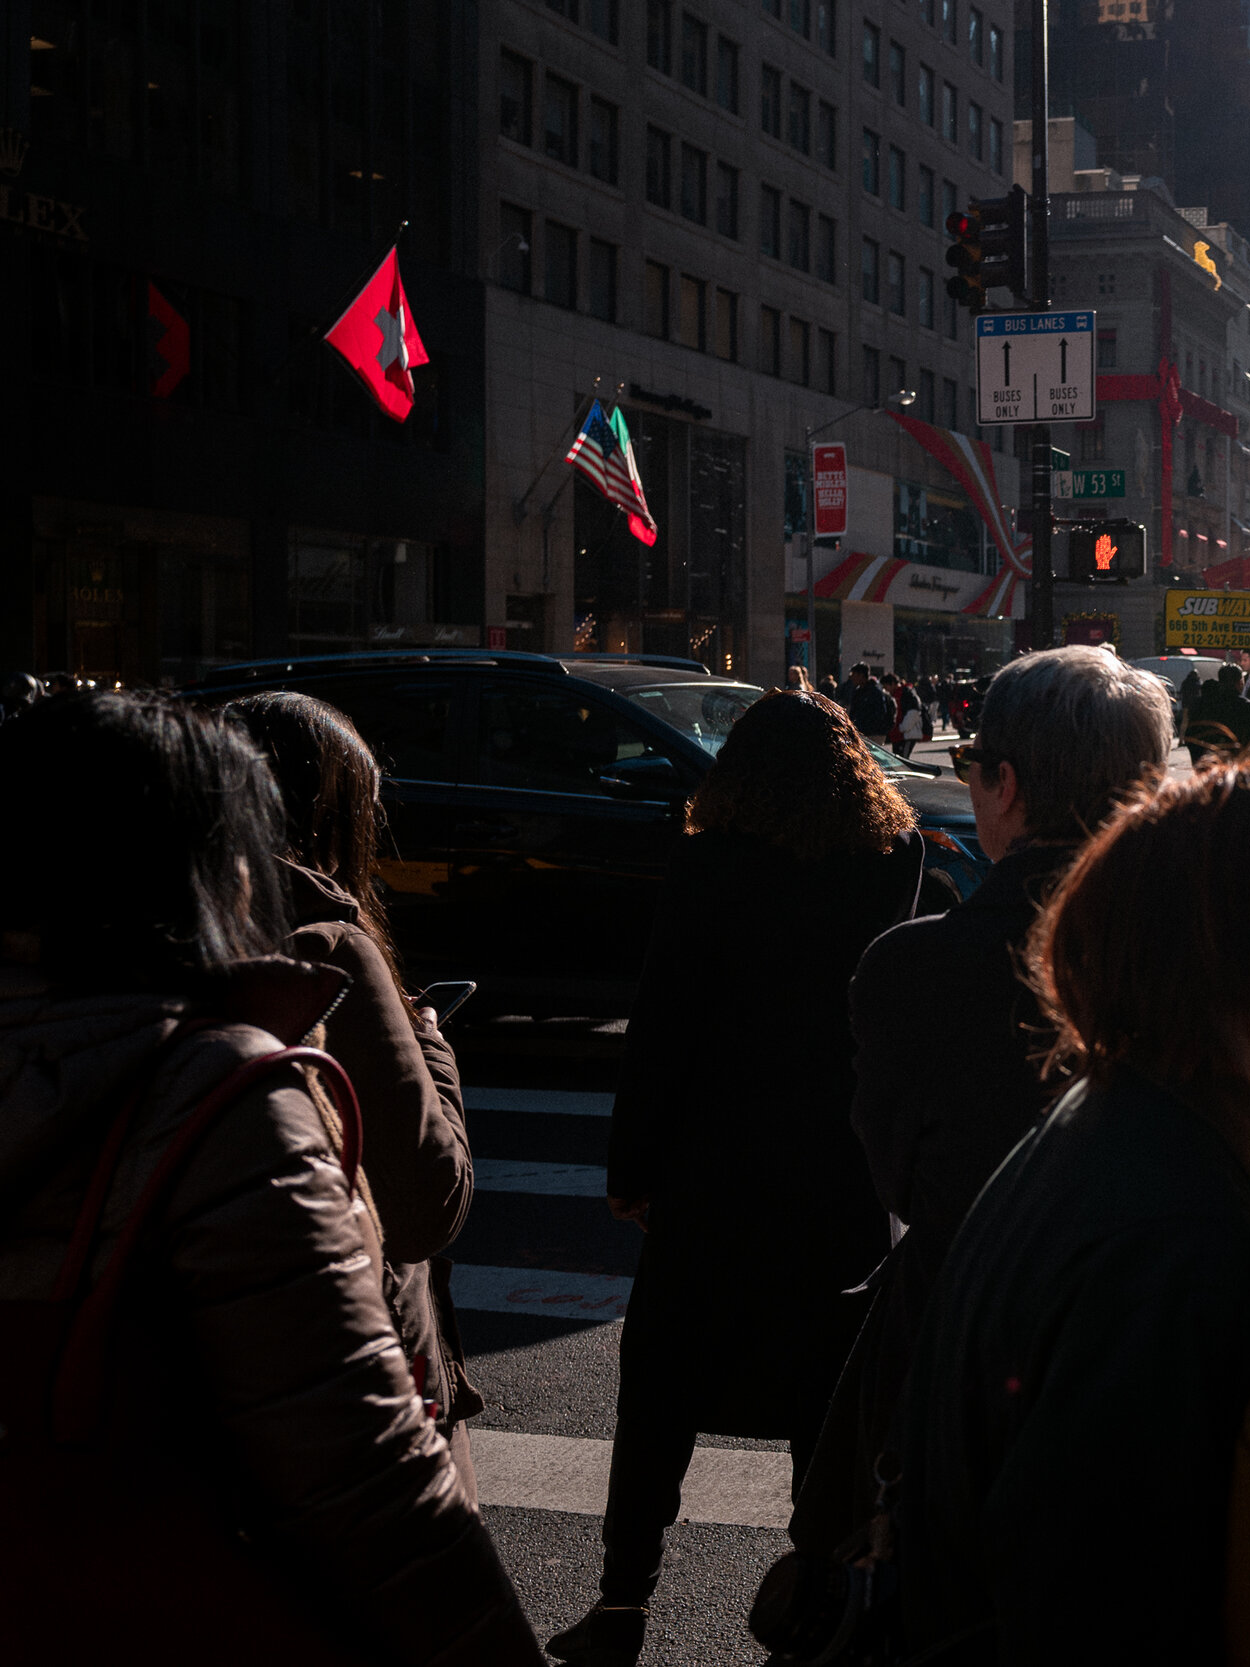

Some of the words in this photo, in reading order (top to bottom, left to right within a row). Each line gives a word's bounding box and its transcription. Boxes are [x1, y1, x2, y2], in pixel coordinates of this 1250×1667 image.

[0, 184, 88, 240] LEX
[1004, 318, 1027, 332] BUS
[1030, 317, 1066, 331] LANES
[993, 390, 1021, 403] BUSES
[1049, 387, 1078, 400] BUSES
[995, 405, 1020, 418] ONLY
[1051, 403, 1076, 415] ONLY
[1073, 473, 1086, 495] W
[1091, 473, 1106, 495] 53
[1111, 472, 1121, 487] St
[1169, 620, 1188, 631] 666
[1191, 620, 1208, 631] 5th
[1212, 621, 1230, 632] Ave
